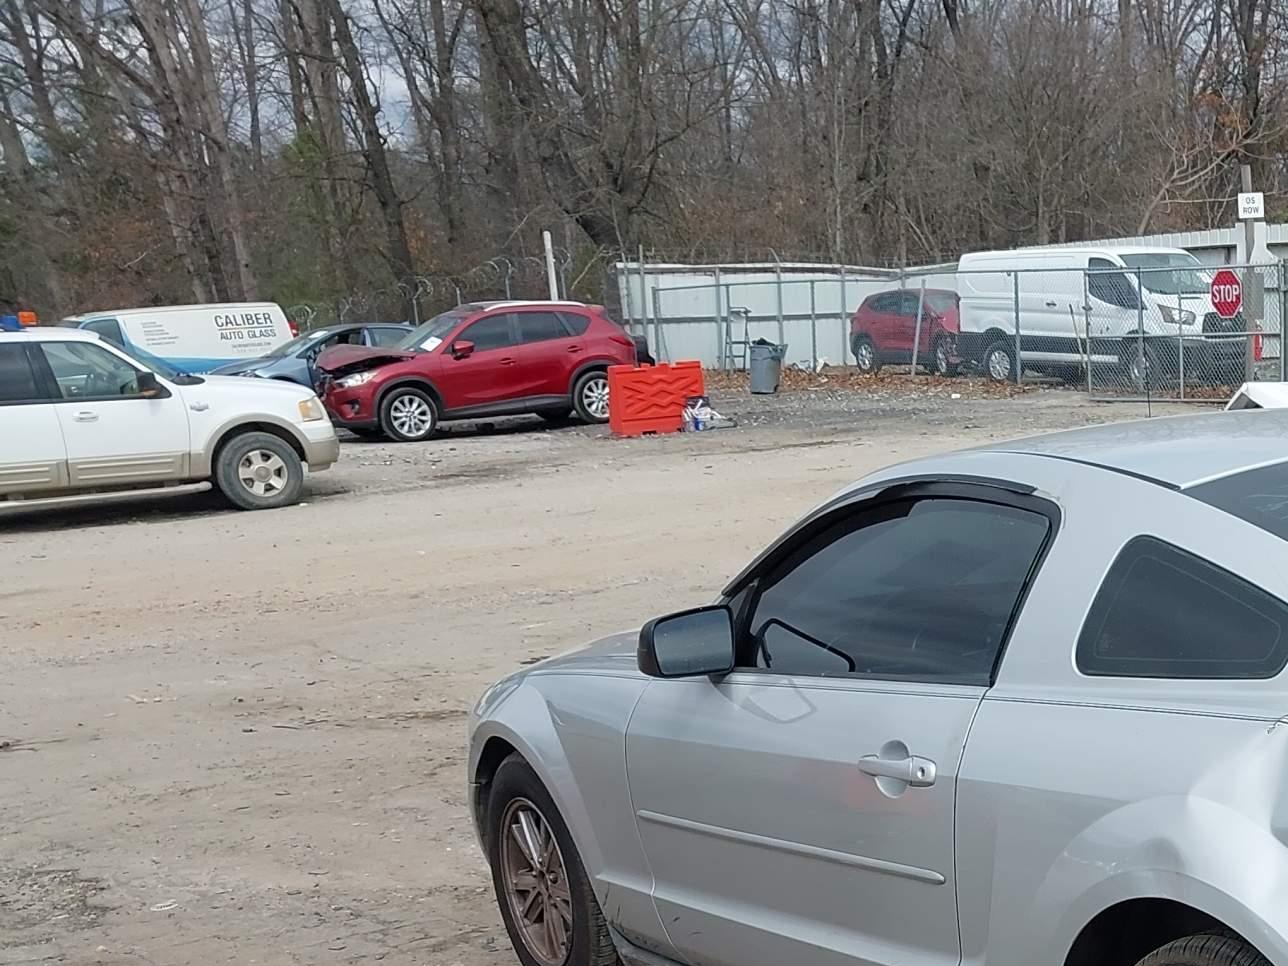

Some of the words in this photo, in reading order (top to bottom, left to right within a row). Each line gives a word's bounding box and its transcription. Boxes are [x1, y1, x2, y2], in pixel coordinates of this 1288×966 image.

[1212, 284, 1240, 303] STOP
[214, 312, 273, 328] CALIBER
[219, 330, 244, 341] AUTO
[247, 328, 277, 339] GLASS
